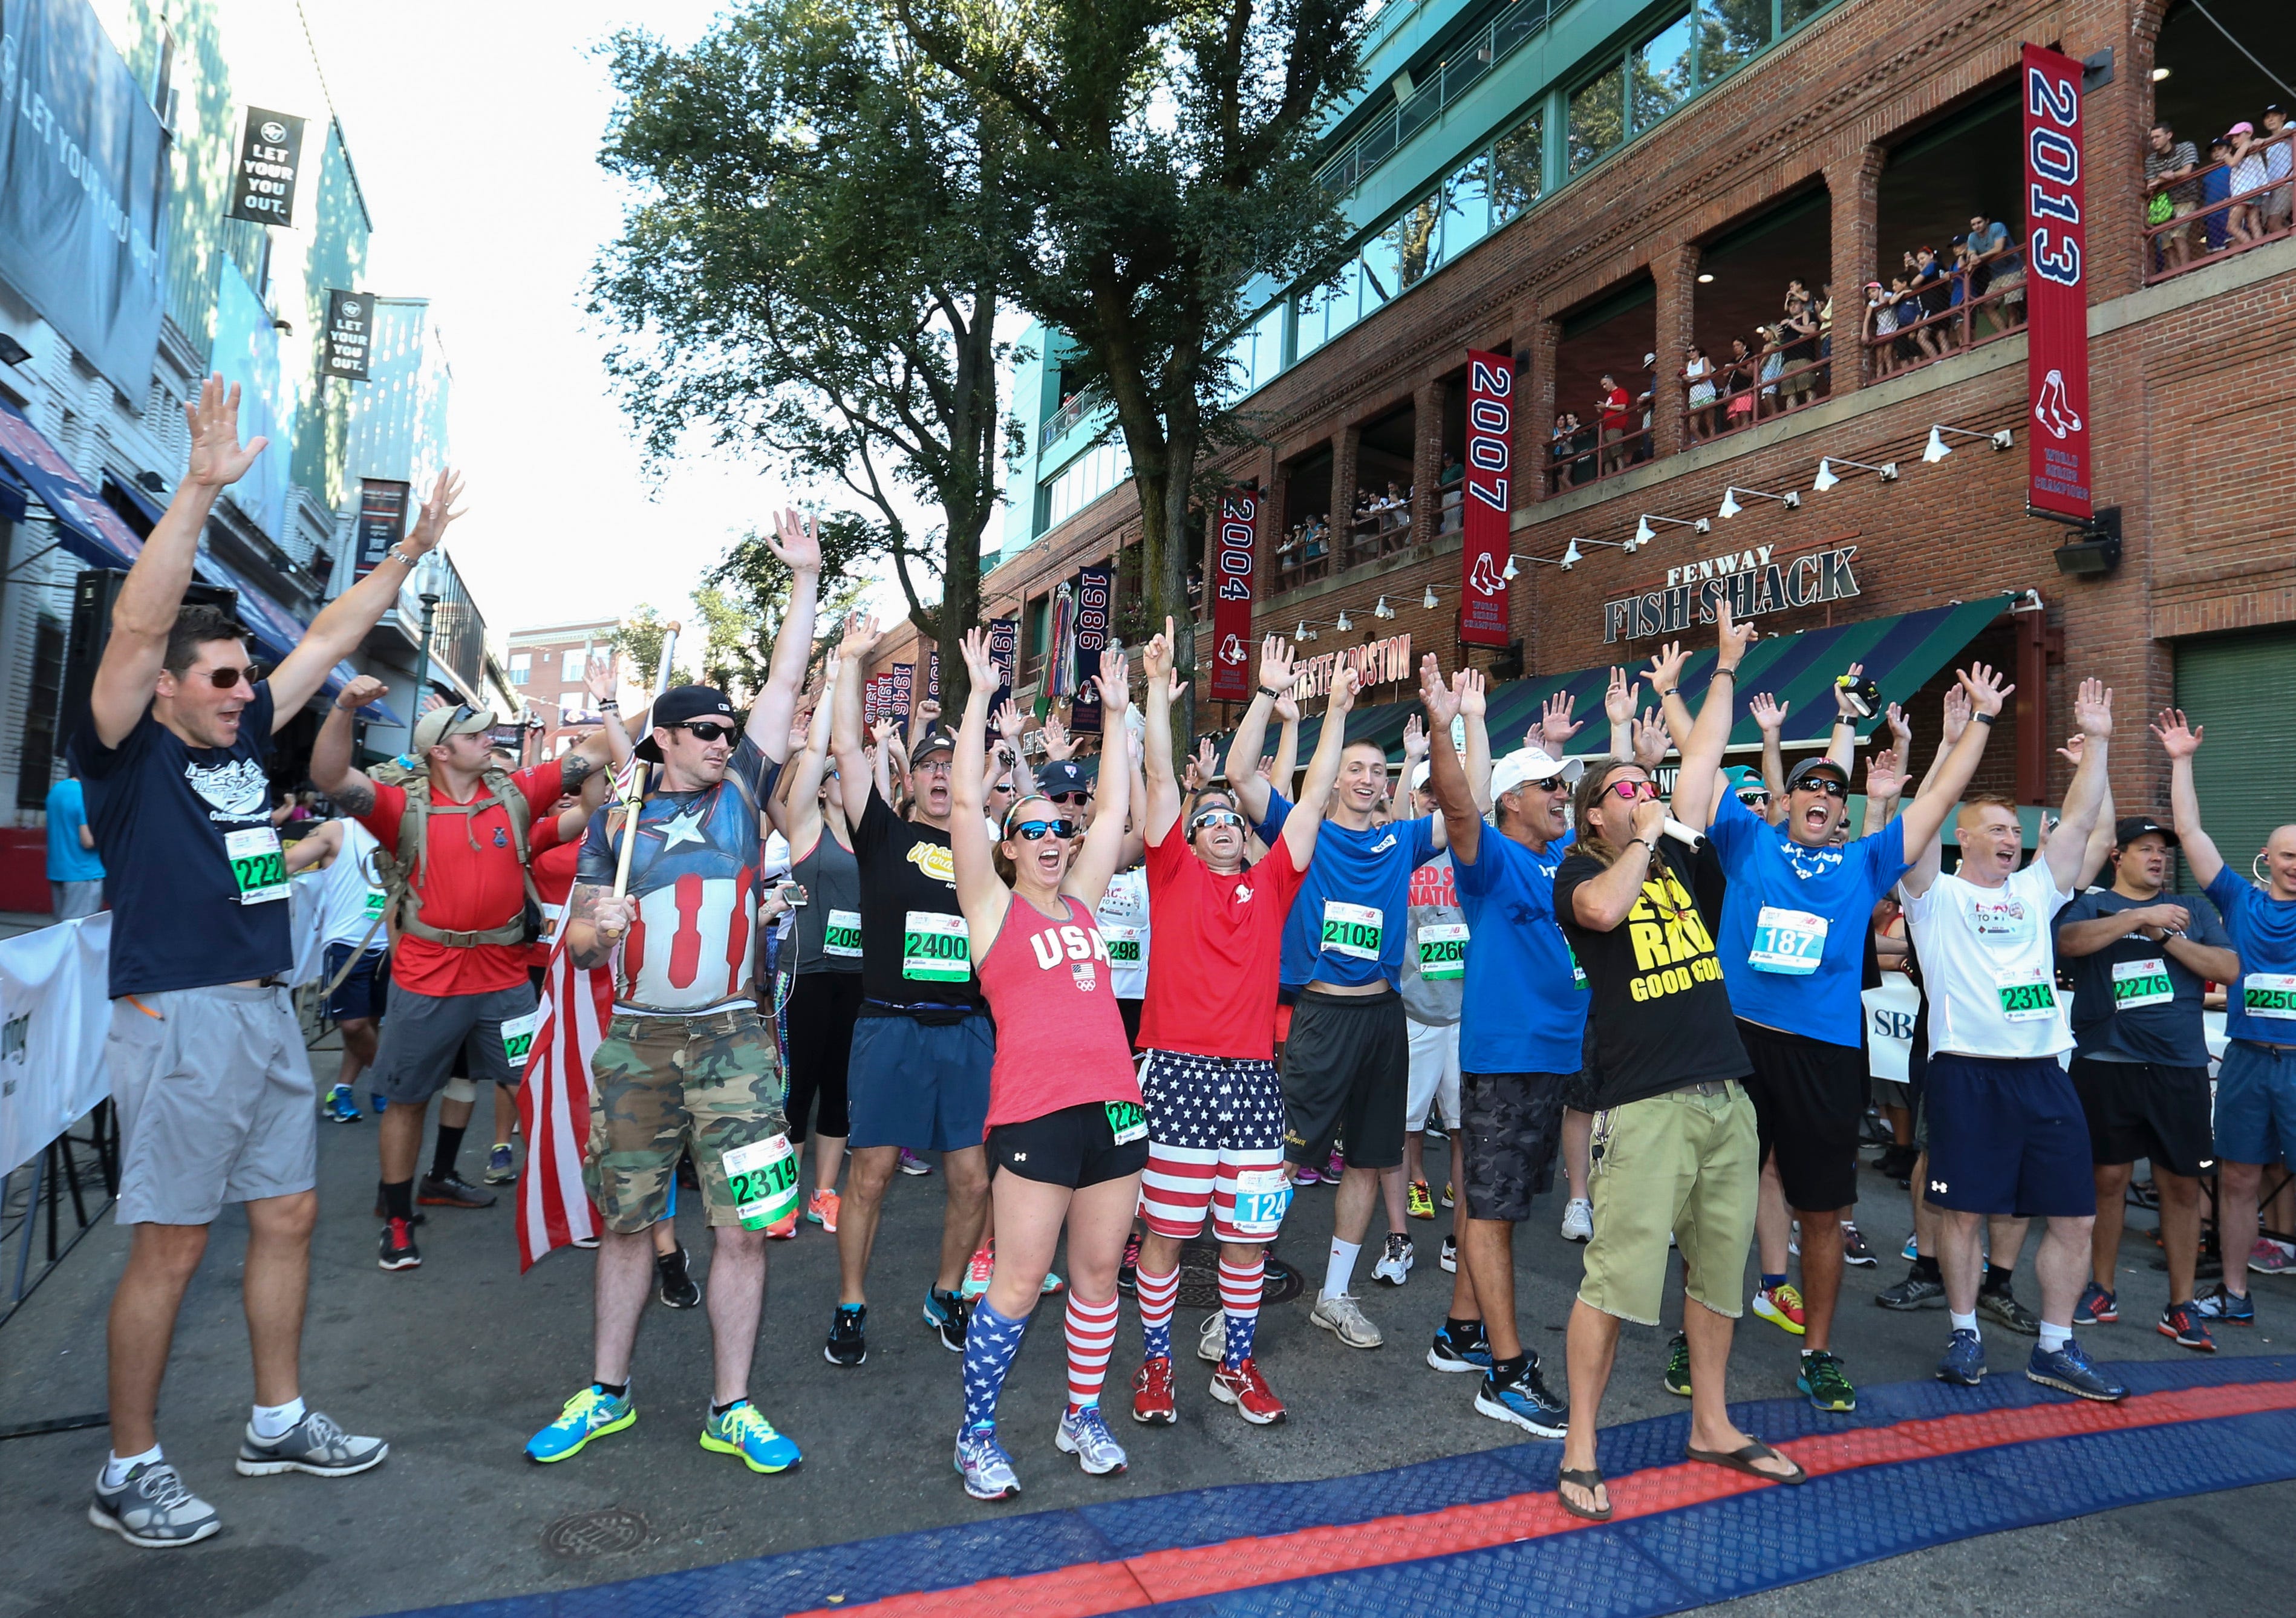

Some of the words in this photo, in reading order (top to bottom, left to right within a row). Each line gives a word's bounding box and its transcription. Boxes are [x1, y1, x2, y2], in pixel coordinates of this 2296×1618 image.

[253, 143, 289, 162] LET
[244, 160, 295, 181] YOUR
[2029, 68, 2080, 287] 2013
[248, 177, 285, 195] YOU
[244, 195, 286, 214] OUT.
[330, 330, 368, 345] YOUR
[336, 319, 364, 331] LET
[331, 357, 364, 371] OUT.
[333, 344, 362, 357] YOU
[1469, 360, 1510, 512] 2007
[1219, 497, 1254, 600] 2004
[1666, 544, 1775, 587] FENWAY
[1603, 584, 1692, 644] FISH
[1700, 546, 1861, 625] SHACK
[1078, 574, 1107, 651] 1986
[1293, 652, 1334, 701] TASTE
[892, 667, 912, 716] 1946
[907, 842, 953, 871] Mara
[826, 927, 862, 948] 209
[907, 933, 967, 961] 2400
[1029, 925, 1112, 971] USA
[1324, 921, 1378, 949] 2103
[1766, 928, 1815, 956] 187
[1107, 941, 1139, 961] 298
[1630, 967, 1693, 1002] GOOD
[2001, 983, 2055, 1011] 2313
[2113, 975, 2170, 1000] 2276
[1874, 1009, 1918, 1040] SB
[507, 1033, 532, 1059] 22
[732, 1156, 797, 1205] 2319
[1247, 1192, 1286, 1222] 124
